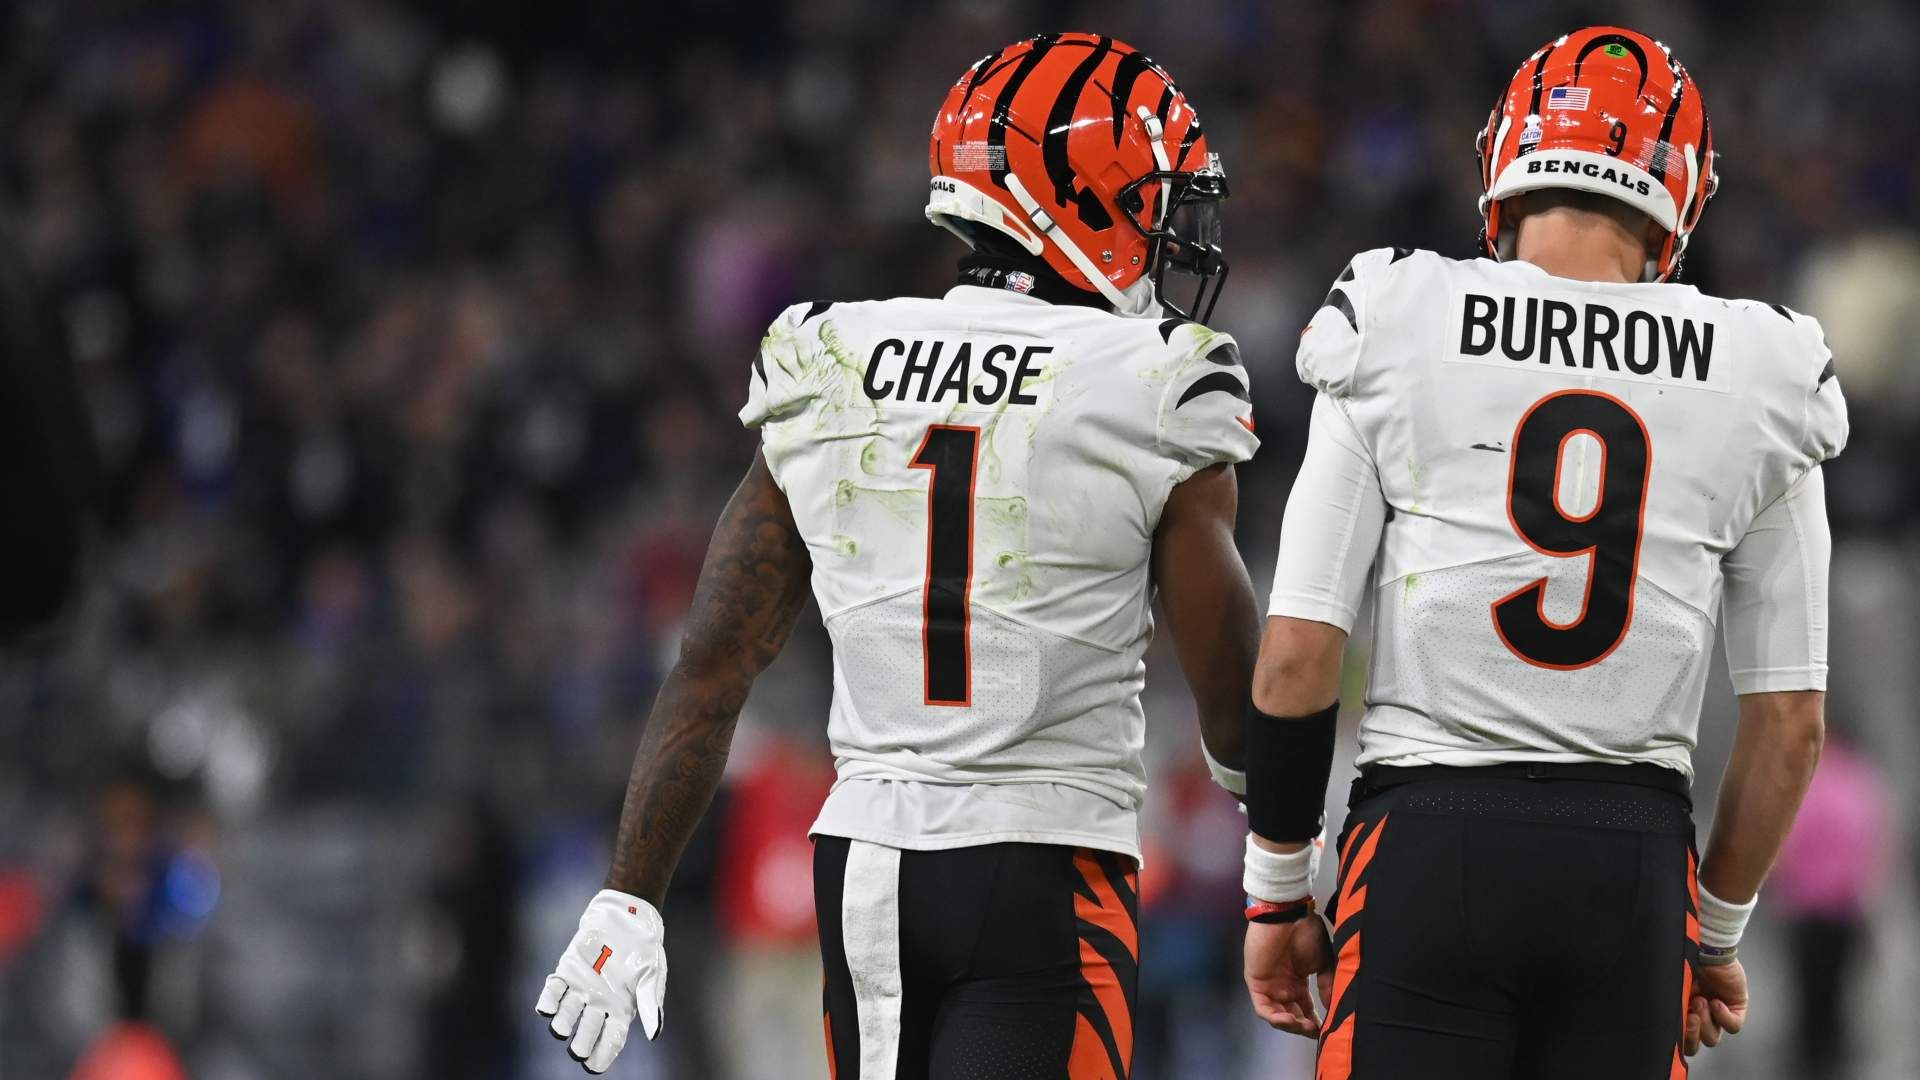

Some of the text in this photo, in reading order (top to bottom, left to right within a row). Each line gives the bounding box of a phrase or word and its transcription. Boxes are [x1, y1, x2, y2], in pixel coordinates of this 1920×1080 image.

[1605, 120, 1627, 157] 9
[1526, 160, 1650, 195] BENGALS
[862, 338, 1054, 405] CHASE
[1460, 294, 1714, 382] BURROW
[907, 424, 981, 707] 1
[1490, 389, 1652, 671] 9
